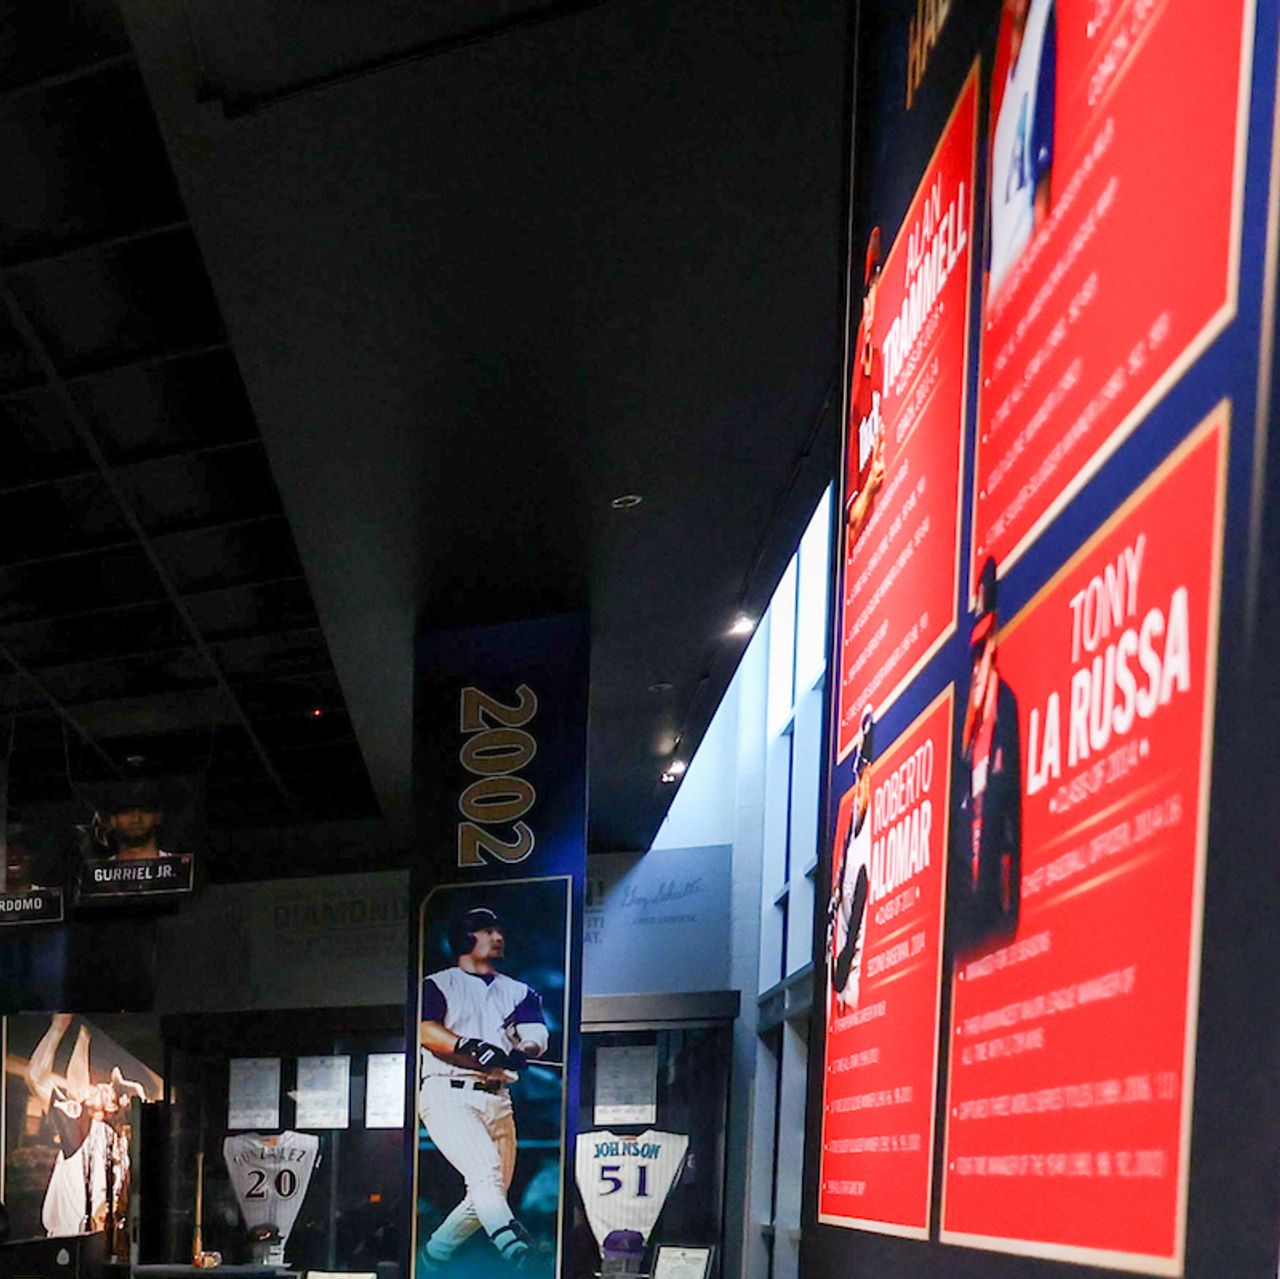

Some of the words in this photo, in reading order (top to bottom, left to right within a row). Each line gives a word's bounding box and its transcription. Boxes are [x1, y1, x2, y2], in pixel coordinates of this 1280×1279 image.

[883, 181, 966, 398] TRAMMELL
[1070, 533, 1146, 663] TONY
[1027, 691, 1061, 795] LA
[1067, 586, 1190, 768] RUSSA
[457, 684, 538, 868] 2002
[874, 739, 933, 835] ROBERTO
[94, 866, 153, 882] GURRIEL
[156, 864, 178, 879] JR.
[869, 800, 933, 904] ALOMAR
[244, 1168, 300, 1200] 20
[594, 1142, 661, 1160] JOHNSON
[599, 1164, 653, 1199] 51
